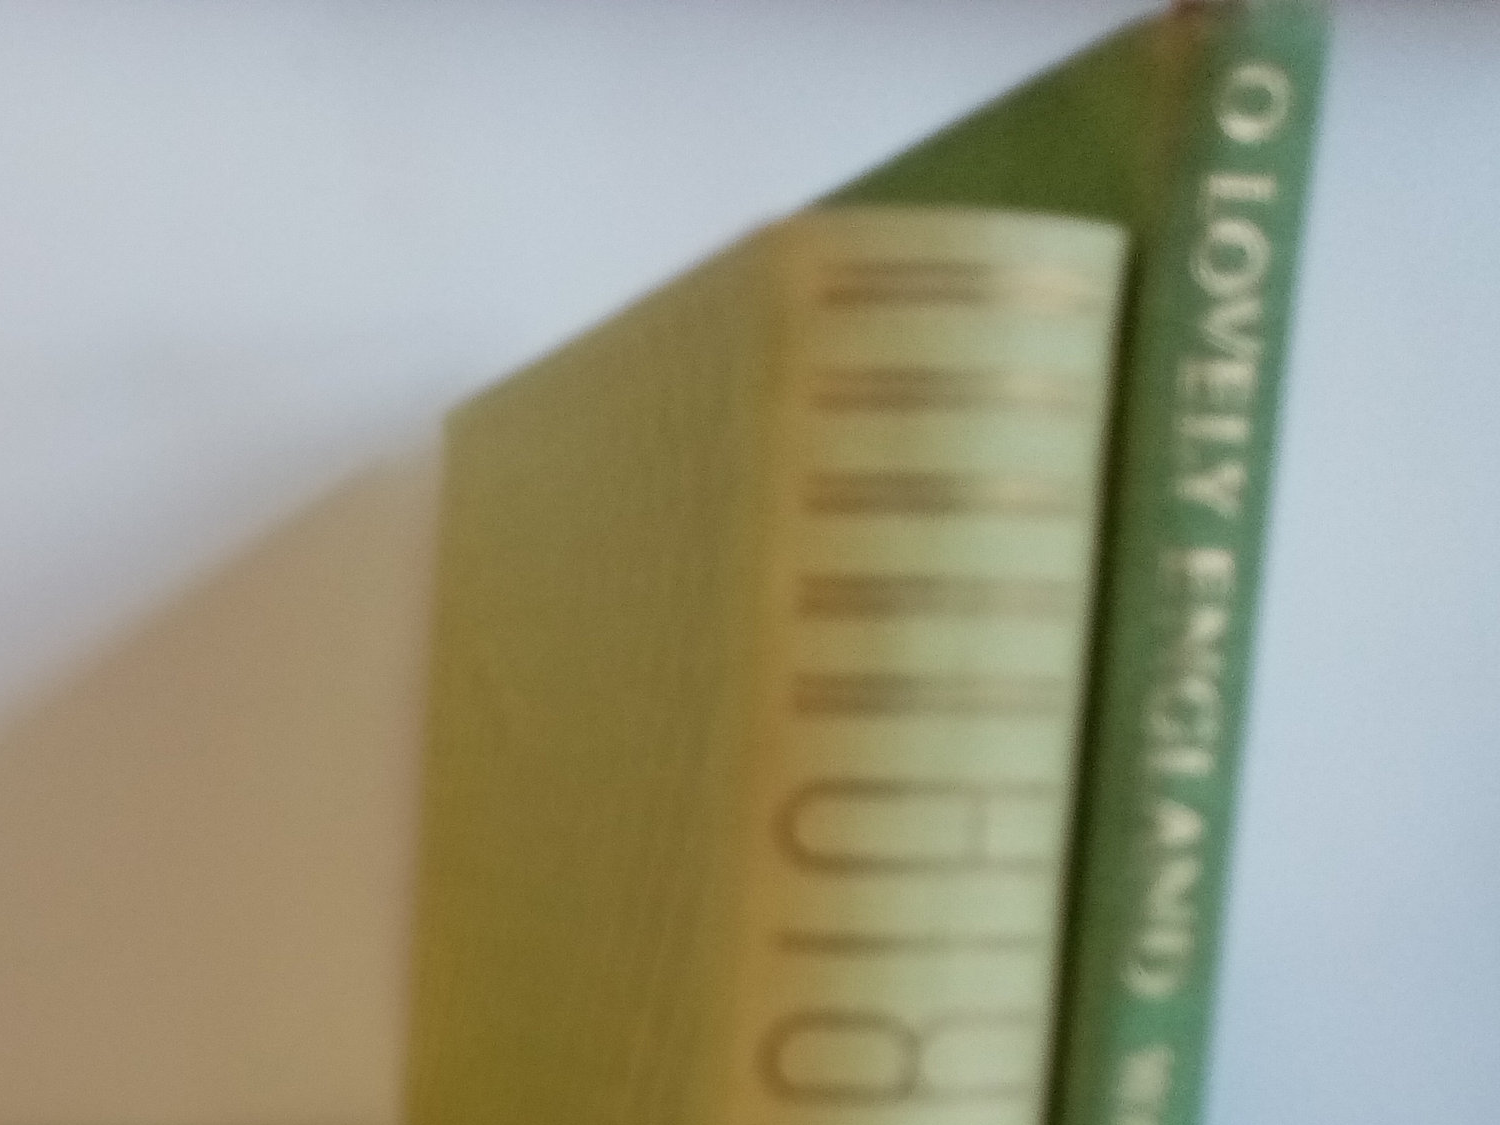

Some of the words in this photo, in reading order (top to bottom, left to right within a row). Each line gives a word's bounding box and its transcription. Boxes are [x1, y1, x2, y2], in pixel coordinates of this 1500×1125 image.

[1214, 60, 1292, 145] O
[1175, 172, 1280, 520] LOVELY
[1126, 546, 1238, 998] ENGLAND
